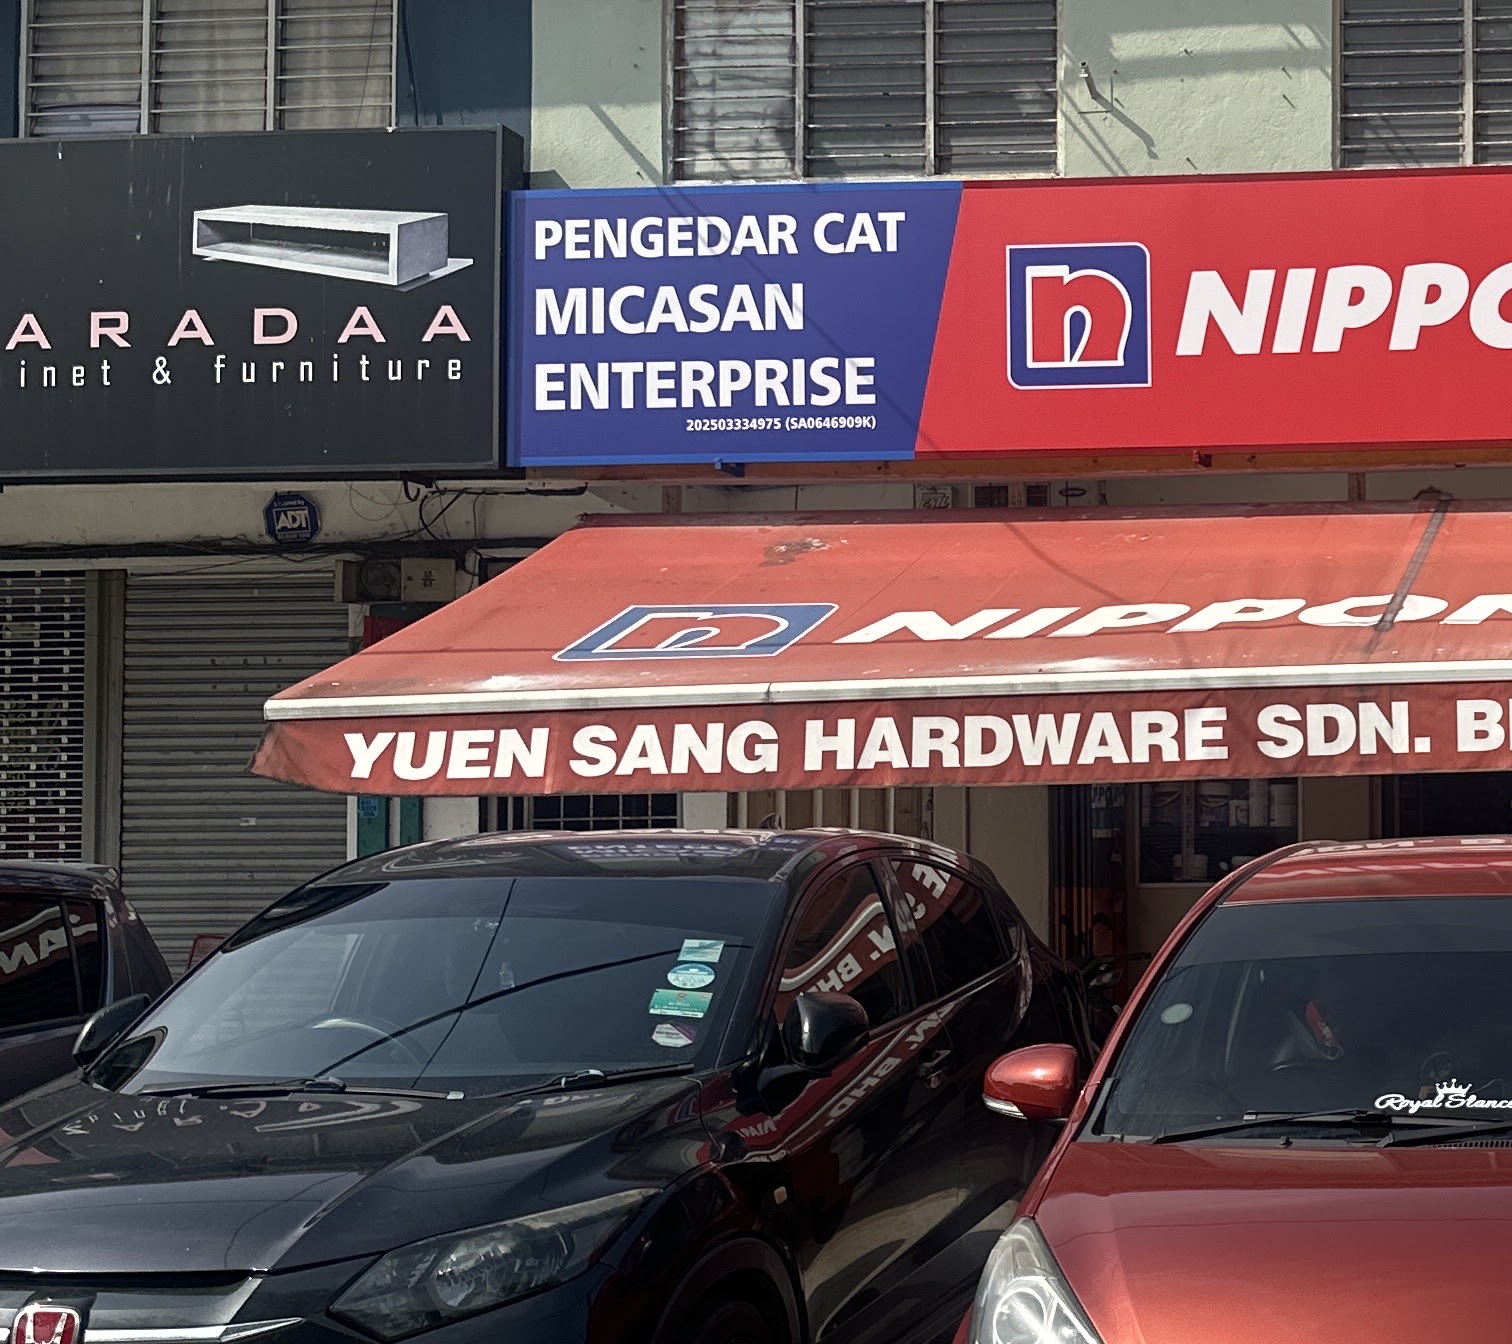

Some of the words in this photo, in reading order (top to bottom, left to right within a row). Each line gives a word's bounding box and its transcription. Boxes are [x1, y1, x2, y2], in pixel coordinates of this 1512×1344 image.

[535, 214, 799, 260] PENGEDAR
[813, 211, 906, 254] CAT
[535, 282, 804, 336] MICASAN
[152, 356, 172, 385] &
[214, 354, 461, 384] furniture
[535, 356, 876, 411] ENTERPRISE
[686, 417, 782, 432] 202503334975
[785, 415, 877, 433] (SA0646909K)
[277, 509, 310, 530] ADT
[343, 727, 550, 781] YUEN
[569, 720, 779, 777] SANG
[803, 707, 1229, 771] HARDWARE
[1257, 701, 1431, 759] SDN.
[1374, 1093, 1443, 1114] Royal
